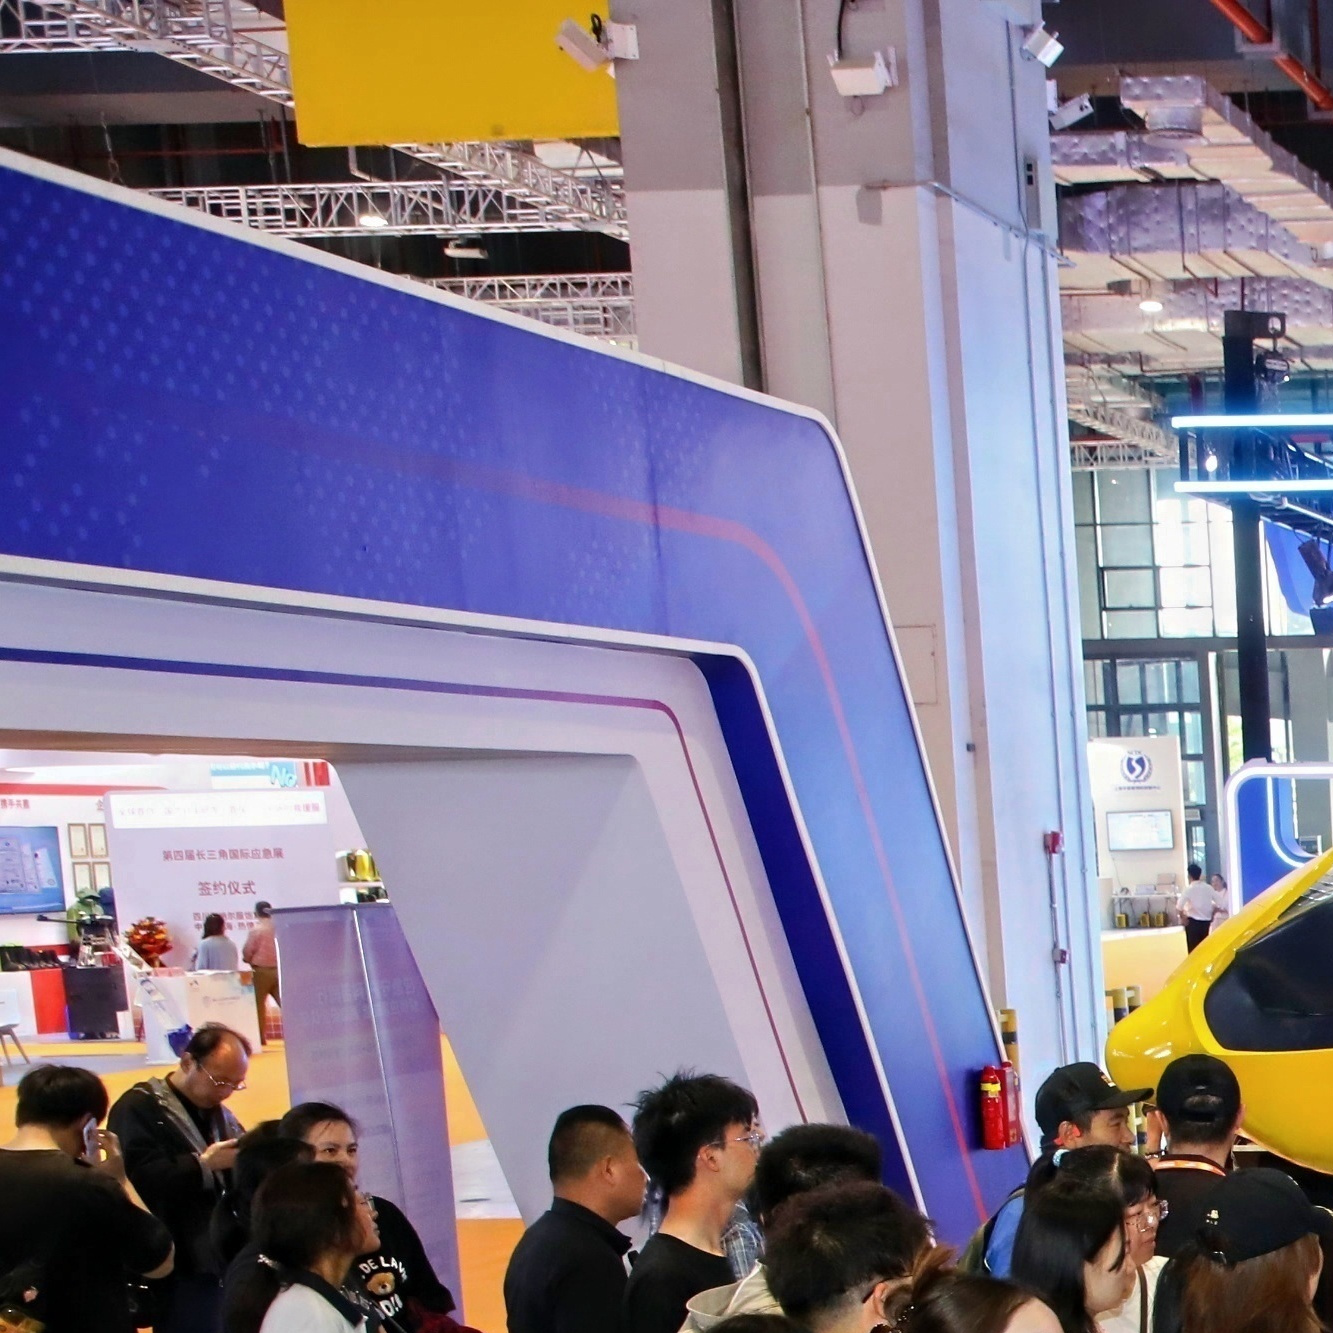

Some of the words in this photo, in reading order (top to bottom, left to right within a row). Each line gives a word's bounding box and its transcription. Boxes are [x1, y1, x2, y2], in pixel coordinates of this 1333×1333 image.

[163, 847, 284, 862] 第四届长三角国际应急展
[198, 880, 256, 896] 签约仪式
